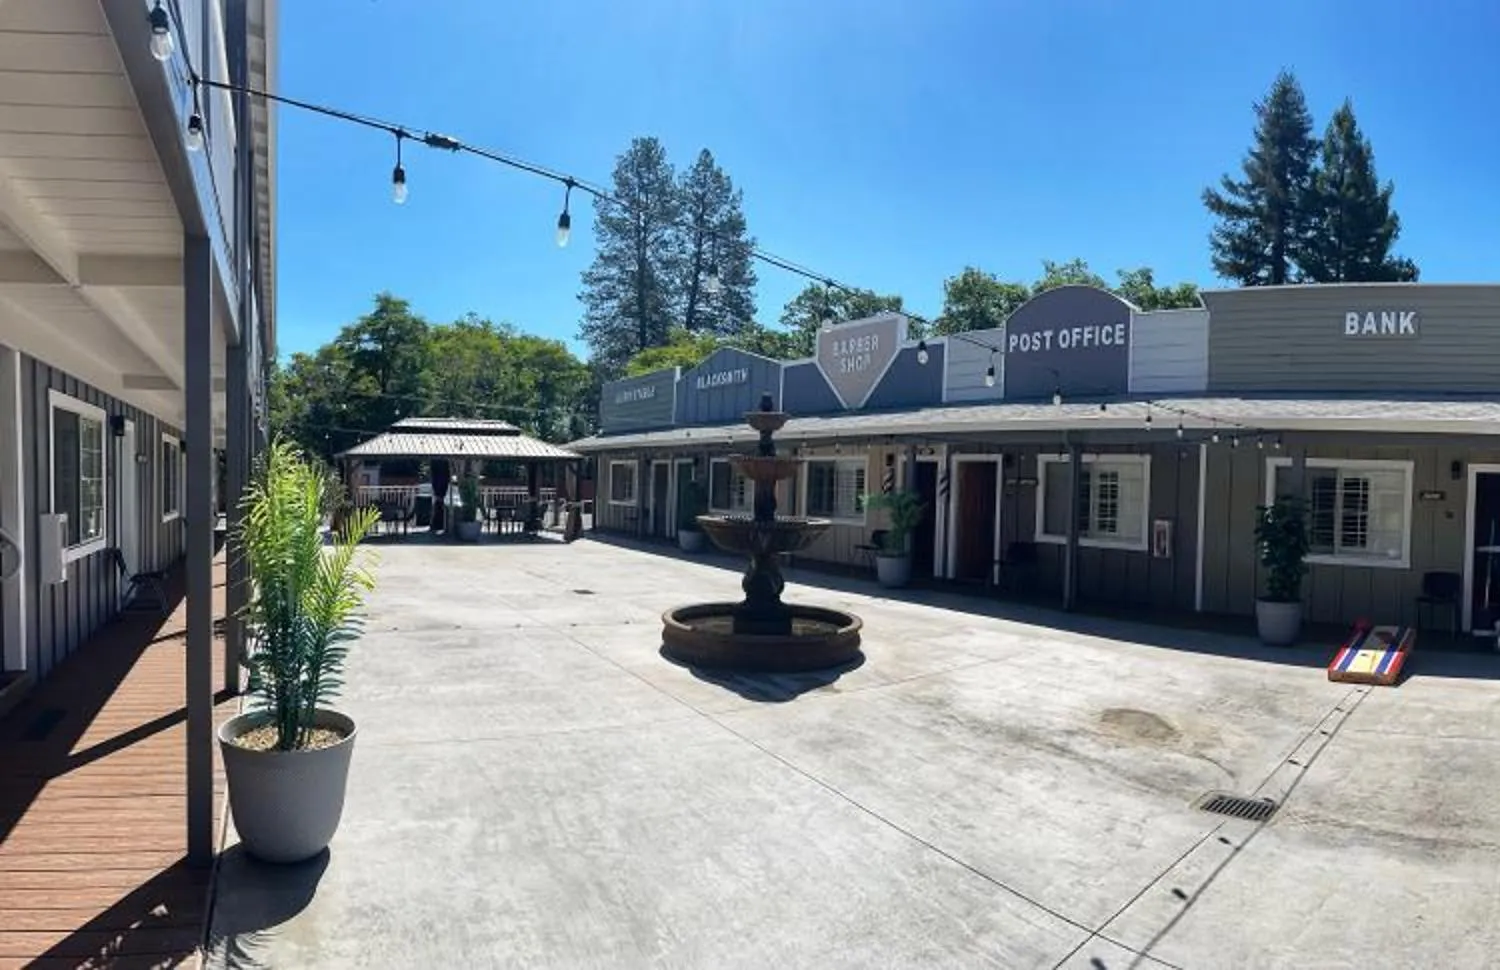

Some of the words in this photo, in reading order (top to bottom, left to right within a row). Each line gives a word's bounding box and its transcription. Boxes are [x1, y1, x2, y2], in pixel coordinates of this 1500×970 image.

[1344, 311, 1416, 335] BANK
[833, 334, 879, 356] BARBER
[1009, 330, 1053, 352] POST
[1059, 323, 1125, 349] OFFICE
[841, 353, 871, 373] SHOP
